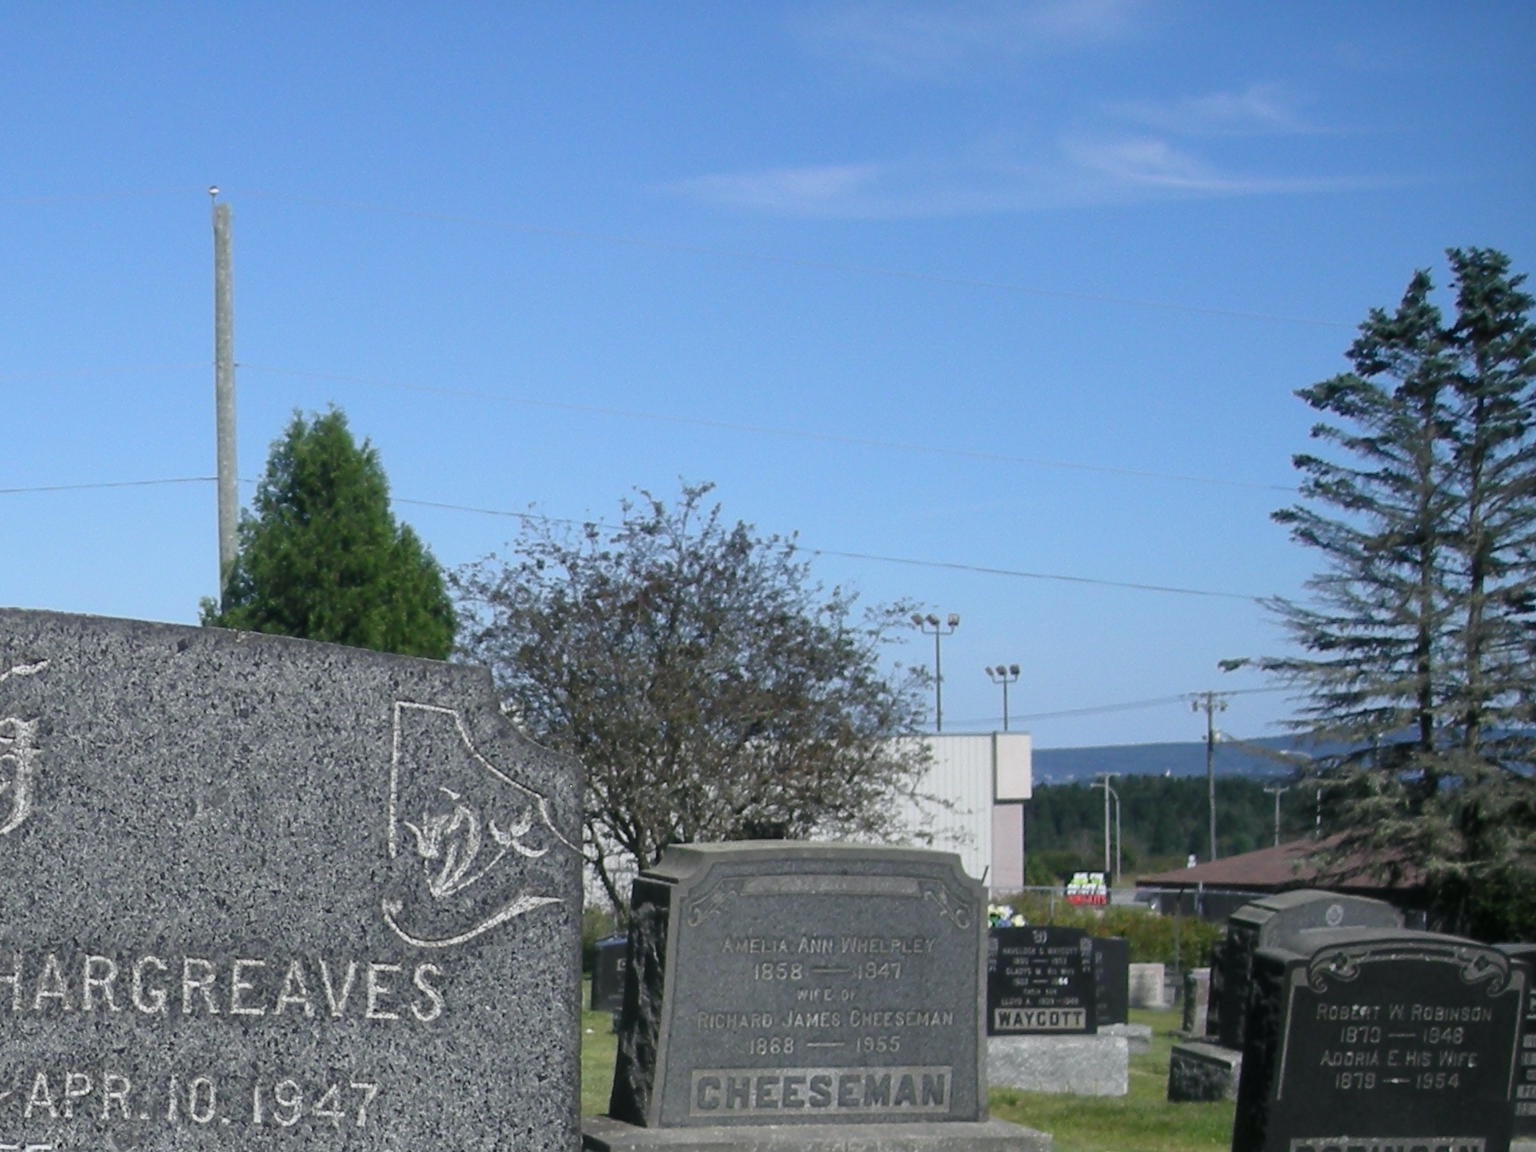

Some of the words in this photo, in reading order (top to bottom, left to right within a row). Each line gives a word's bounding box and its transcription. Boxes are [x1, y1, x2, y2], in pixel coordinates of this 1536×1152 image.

[722, 937, 789, 953] AMELIA
[798, 937, 834, 953] ANN
[841, 937, 936, 953] WHELPLEY
[754, 963, 804, 980] 1858
[697, 1011, 773, 1029] RICHARD
[781, 1010, 842, 1028] JAMES
[849, 1009, 954, 1027] CHEESEMAN
[998, 1011, 1082, 1027] WAYCOTT
[1316, 1003, 1381, 1021] ROBERT
[1411, 1003, 1493, 1022] ROBINSON
[1405, 1051, 1431, 1067] HIS
[1439, 1051, 1478, 1069] WIFE
[24, 1072, 151, 1121] APR.
[254, 1079, 379, 1128] 1947
[697, 1073, 945, 1110] CHEESEMAN
